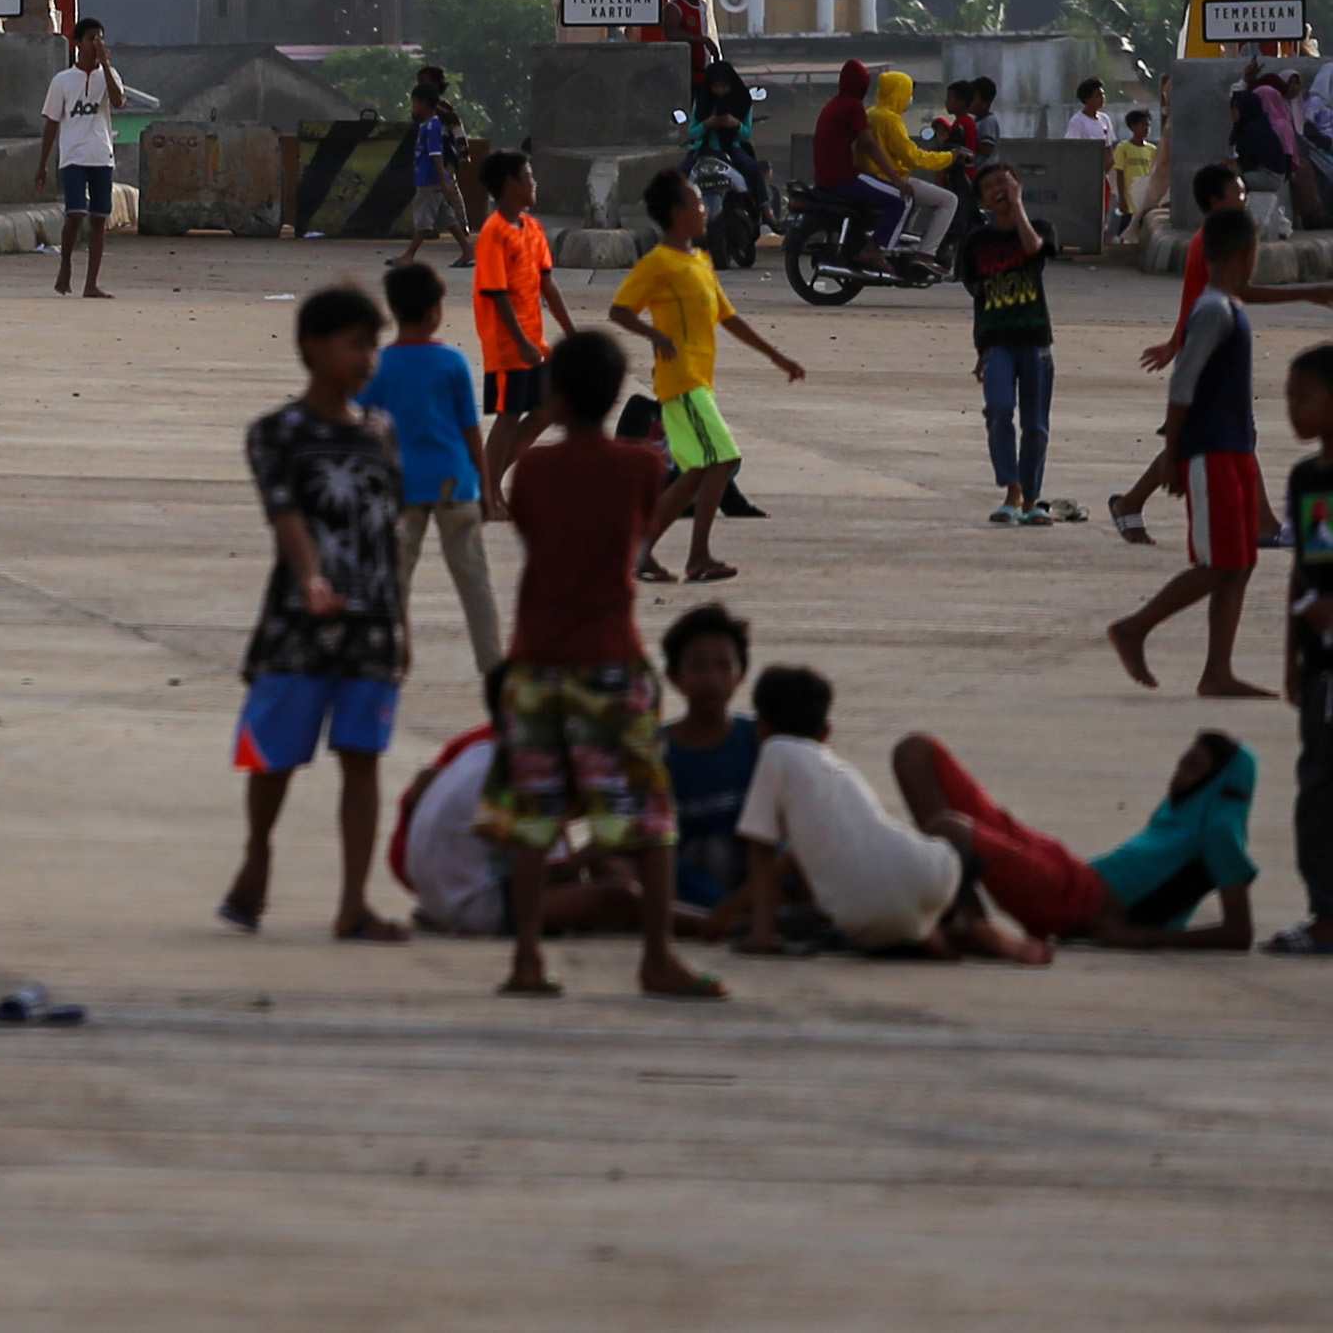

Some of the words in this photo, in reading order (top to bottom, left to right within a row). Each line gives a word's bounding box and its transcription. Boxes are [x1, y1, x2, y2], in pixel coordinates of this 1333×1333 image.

[590, 5, 633, 19] KARTU
[1214, 7, 1296, 20] TEMPELKAN
[1234, 20, 1277, 33] KARTU
